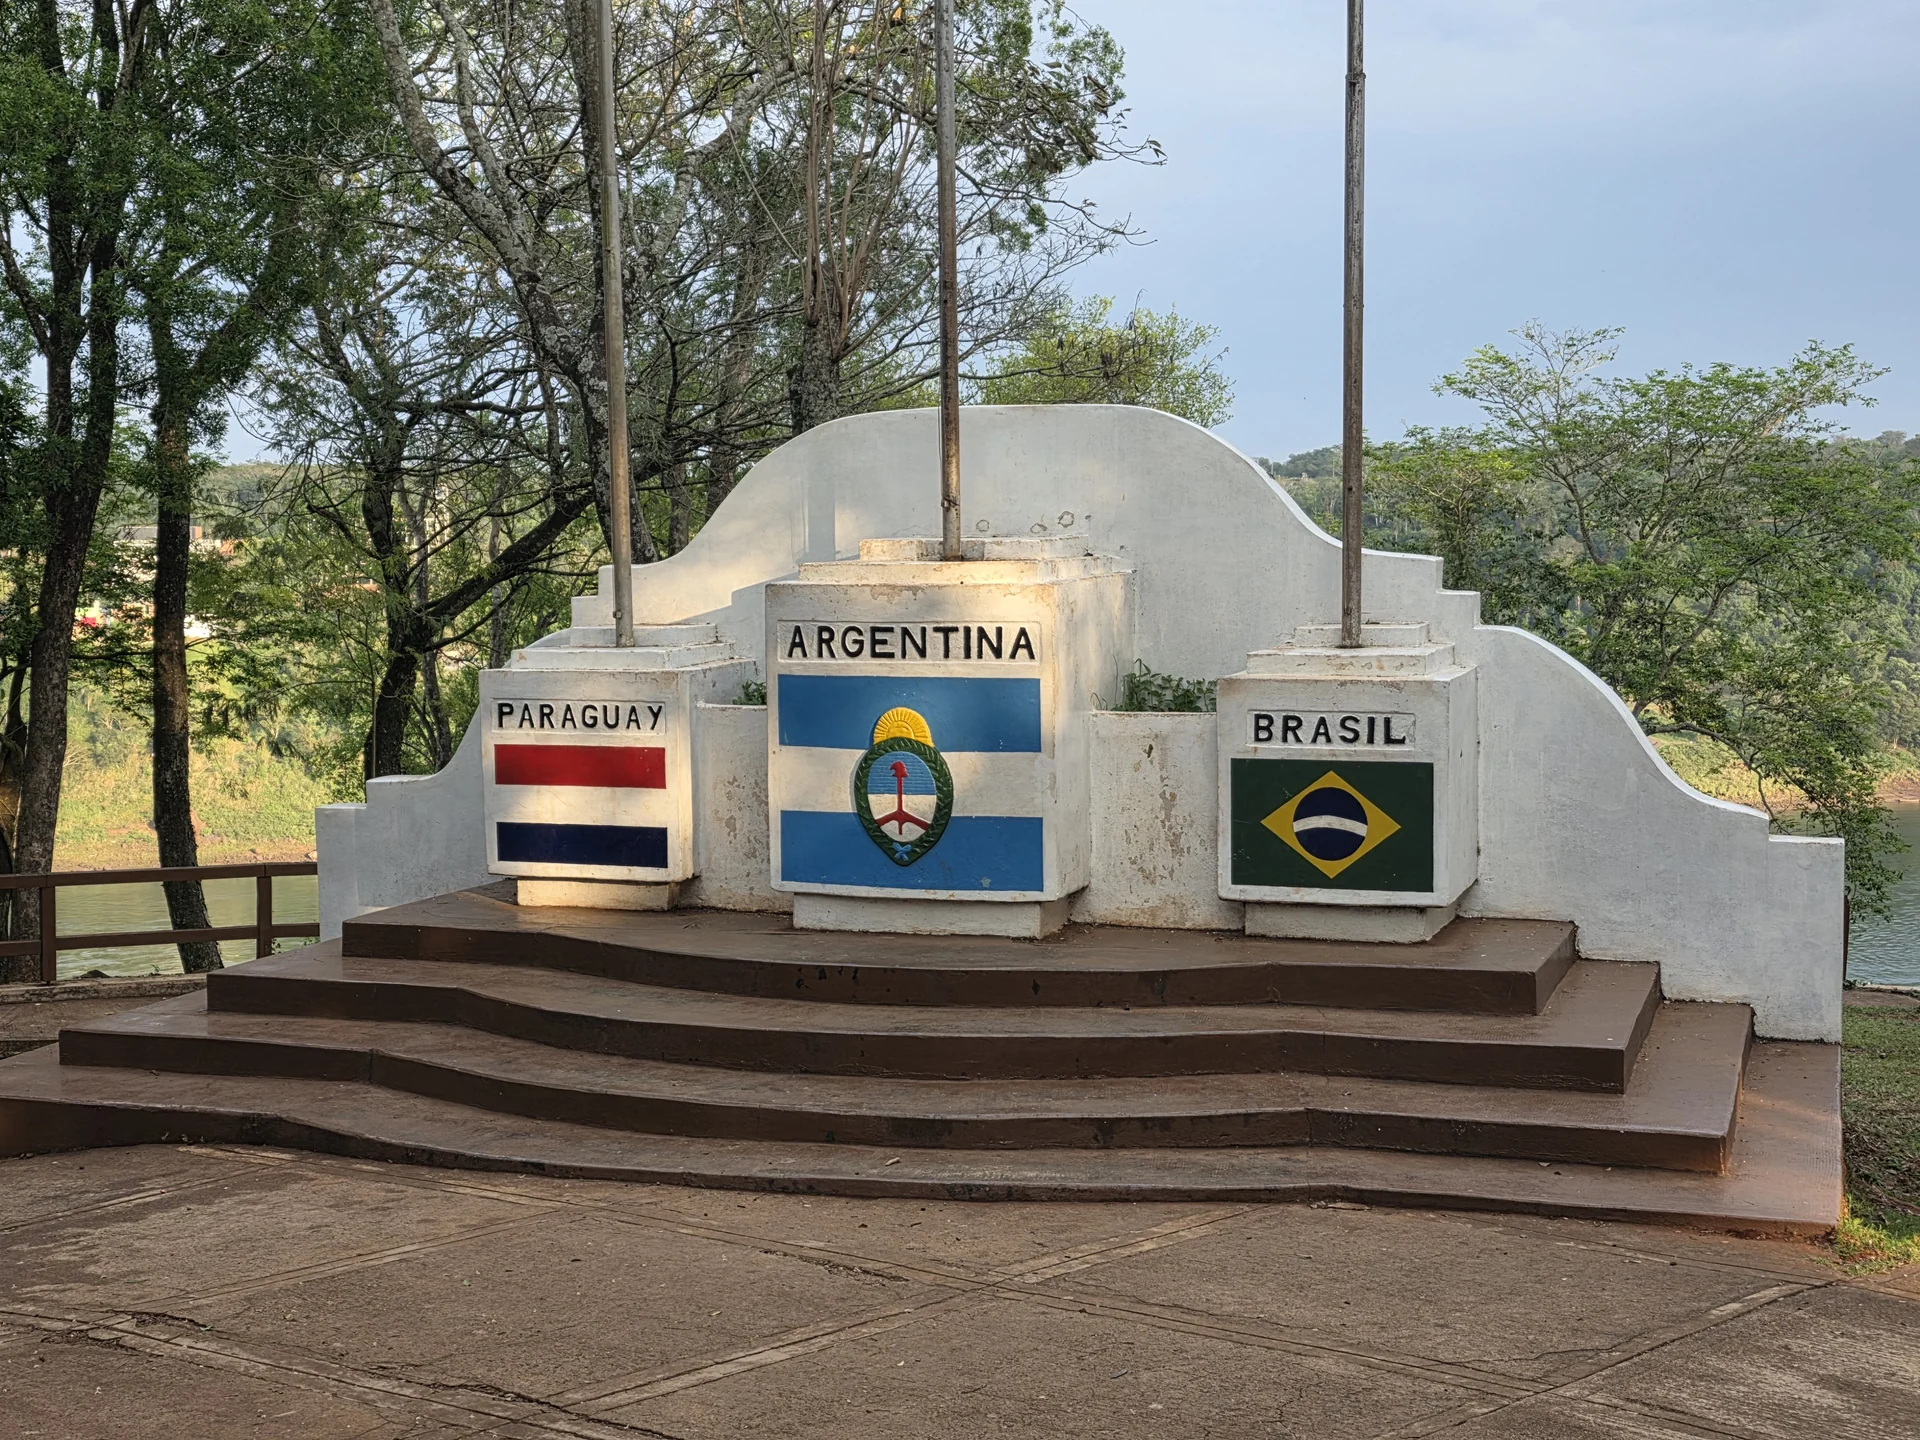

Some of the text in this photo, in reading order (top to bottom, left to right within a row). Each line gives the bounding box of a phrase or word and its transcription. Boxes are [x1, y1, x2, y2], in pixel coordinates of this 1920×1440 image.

[787, 625, 1035, 660] ARGENTINA
[498, 702, 663, 731] PARAGUAY
[1253, 713, 1406, 745] BRASIL
